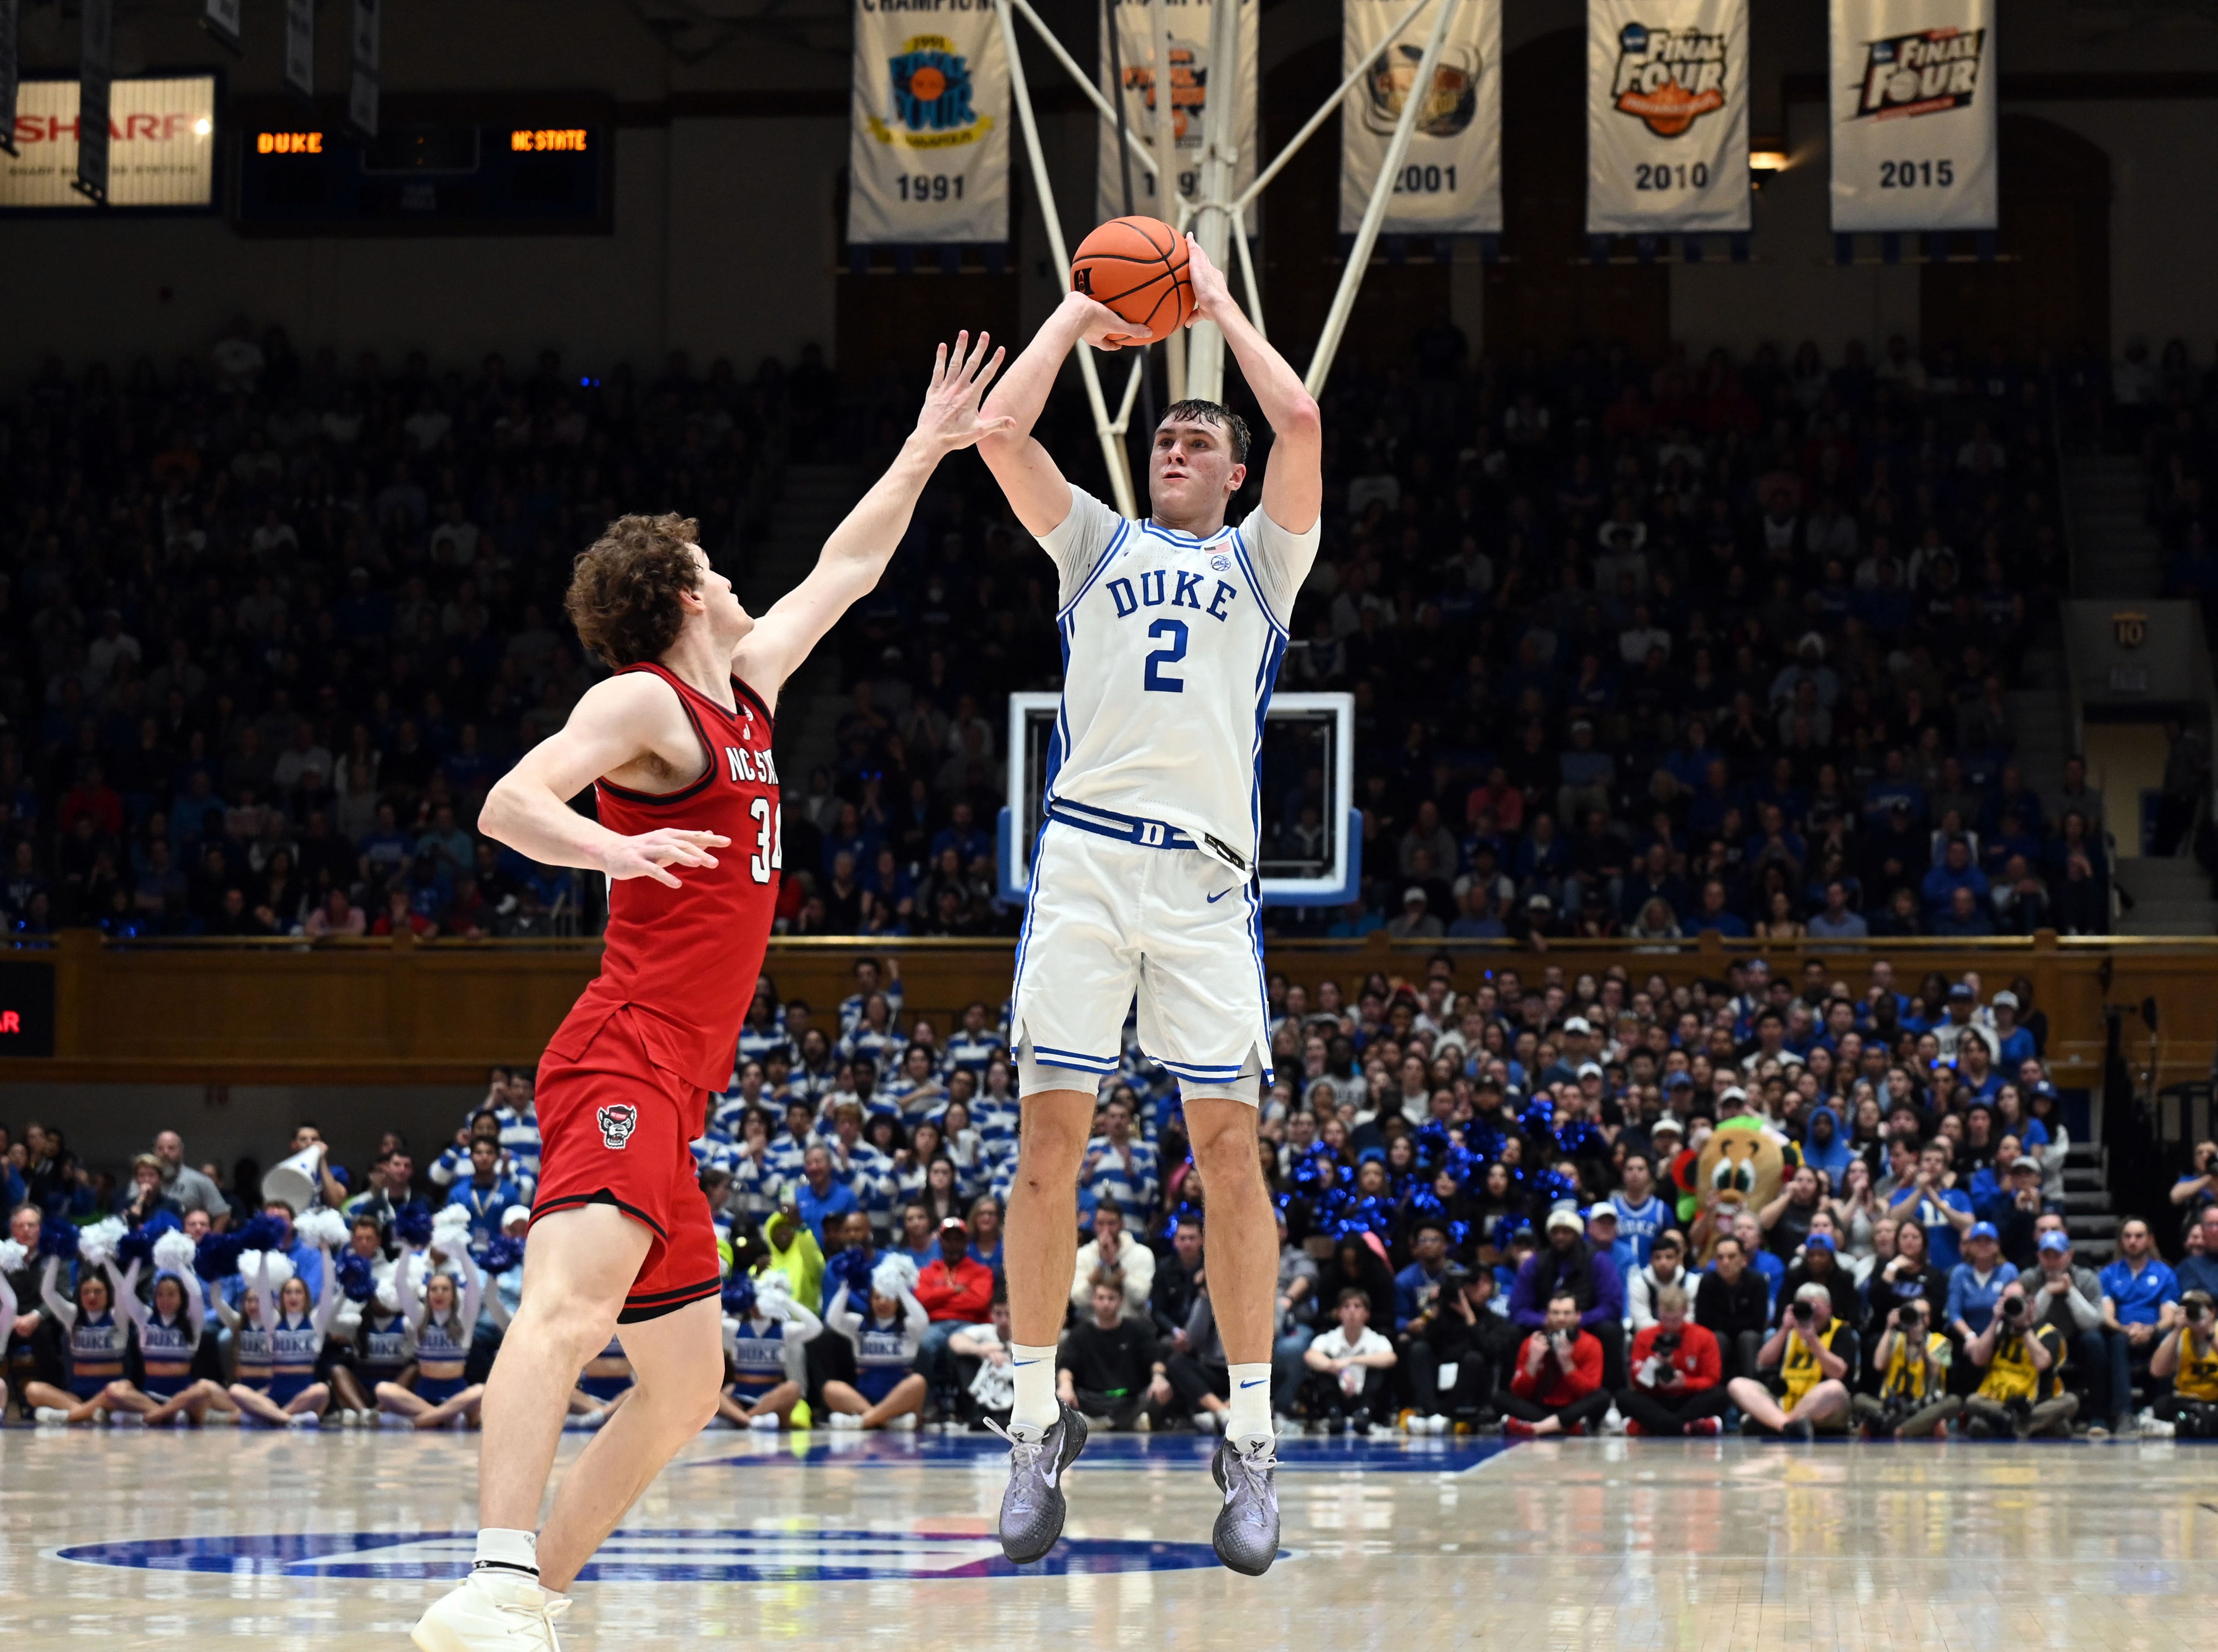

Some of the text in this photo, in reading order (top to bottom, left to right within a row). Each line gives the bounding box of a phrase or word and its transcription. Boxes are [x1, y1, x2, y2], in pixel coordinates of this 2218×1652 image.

[257, 132, 323, 153] DUKE
[898, 174, 964, 201] 1991
[1636, 162, 1708, 190] 2010
[1880, 159, 1954, 188] 2015
[1106, 570, 1236, 622] DUKE
[1144, 618, 1189, 693] 2
[725, 746, 756, 781] NC
[0, 1010, 20, 1033] R
